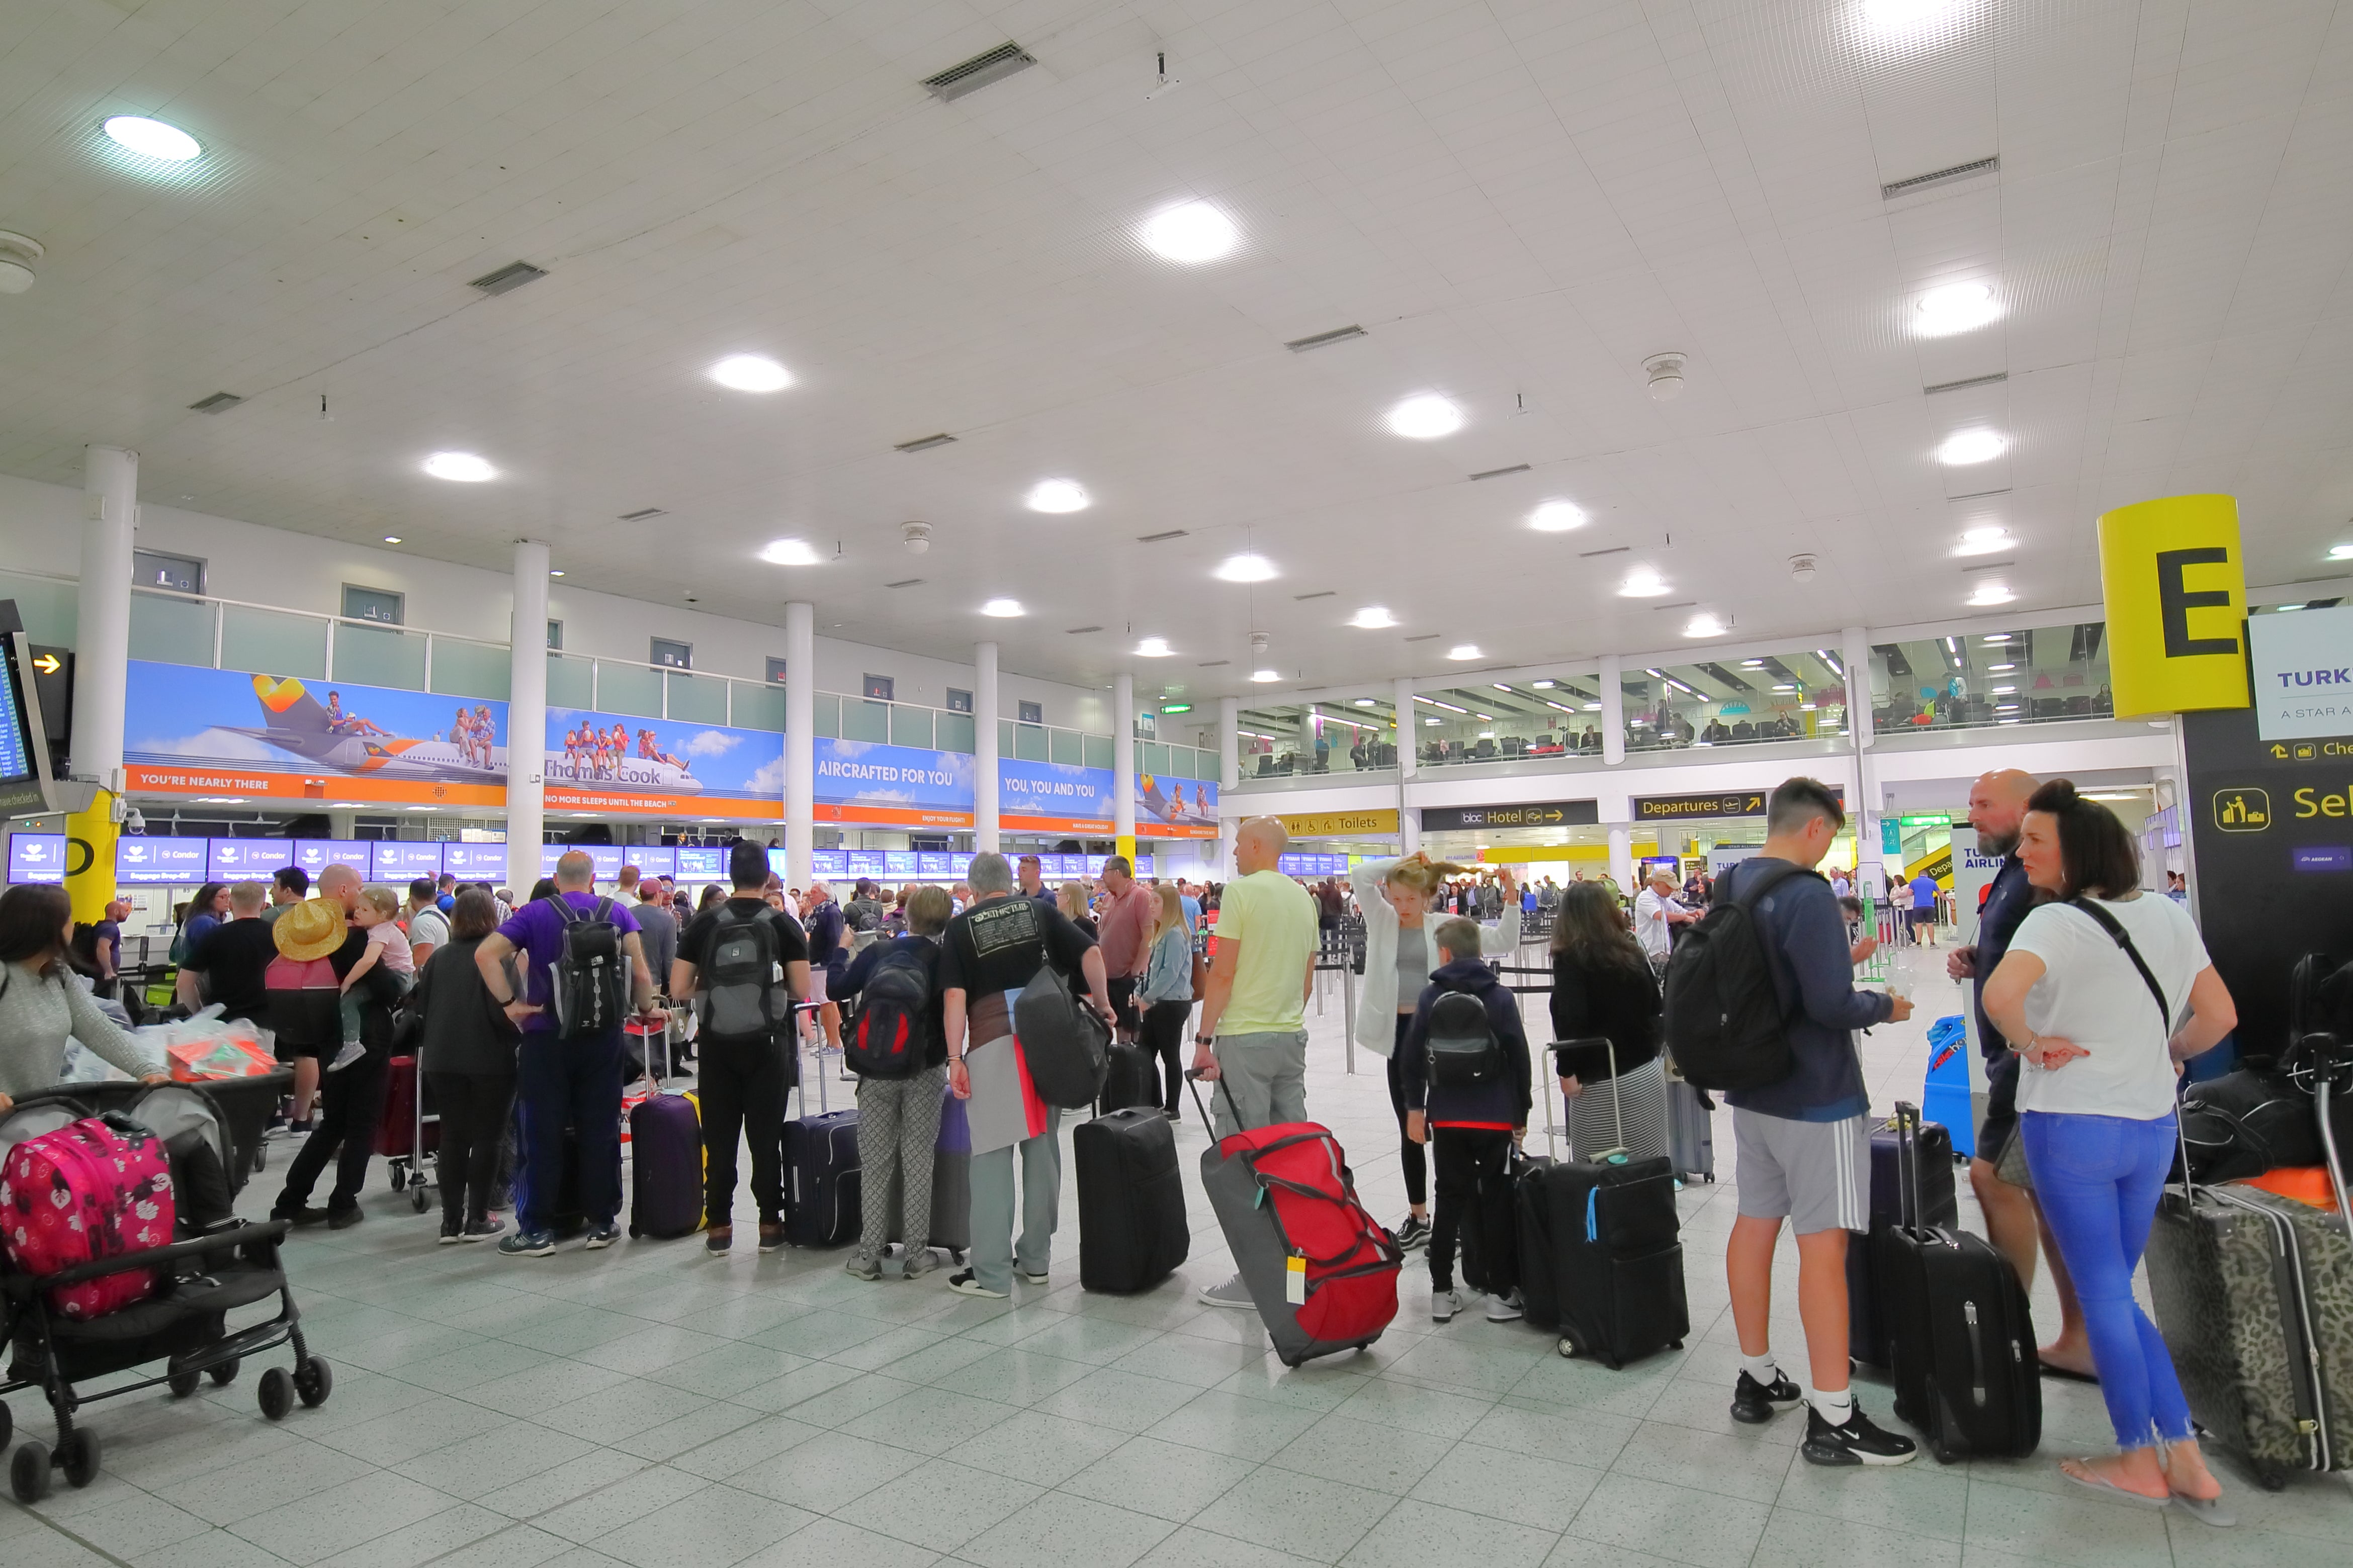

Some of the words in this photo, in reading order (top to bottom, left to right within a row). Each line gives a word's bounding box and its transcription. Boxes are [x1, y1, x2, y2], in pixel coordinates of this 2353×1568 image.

[2156, 547, 2239, 658] E
[2278, 668, 2353, 687] TURK
[2281, 710, 2291, 719] A
[2296, 707, 2335, 718] STAR
[619, 765, 661, 784] Cook
[818, 760, 898, 782] AIRCRAFTED
[902, 768, 925, 784] FOR
[927, 770, 952, 786] YOU
[189, 777, 232, 788] NEARLY
[234, 779, 269, 790] THERE
[1005, 778, 1029, 794] YOU,
[1030, 780, 1052, 794] YOU
[1054, 782, 1074, 796] AND
[1075, 784, 1095, 798] YOU
[32, 792, 39, 802] in
[545, 795, 558, 803] NO
[559, 796, 580, 804] MORE
[582, 797, 607, 805] SLEEPS
[608, 798, 629, 806] UNTIL
[1643, 801, 1719, 816] Departures
[1338, 816, 1377, 829] Toilets
[1463, 813, 1483, 823] bloc
[1488, 809, 1522, 823] Hotel
[172, 851, 199, 859] Condor
